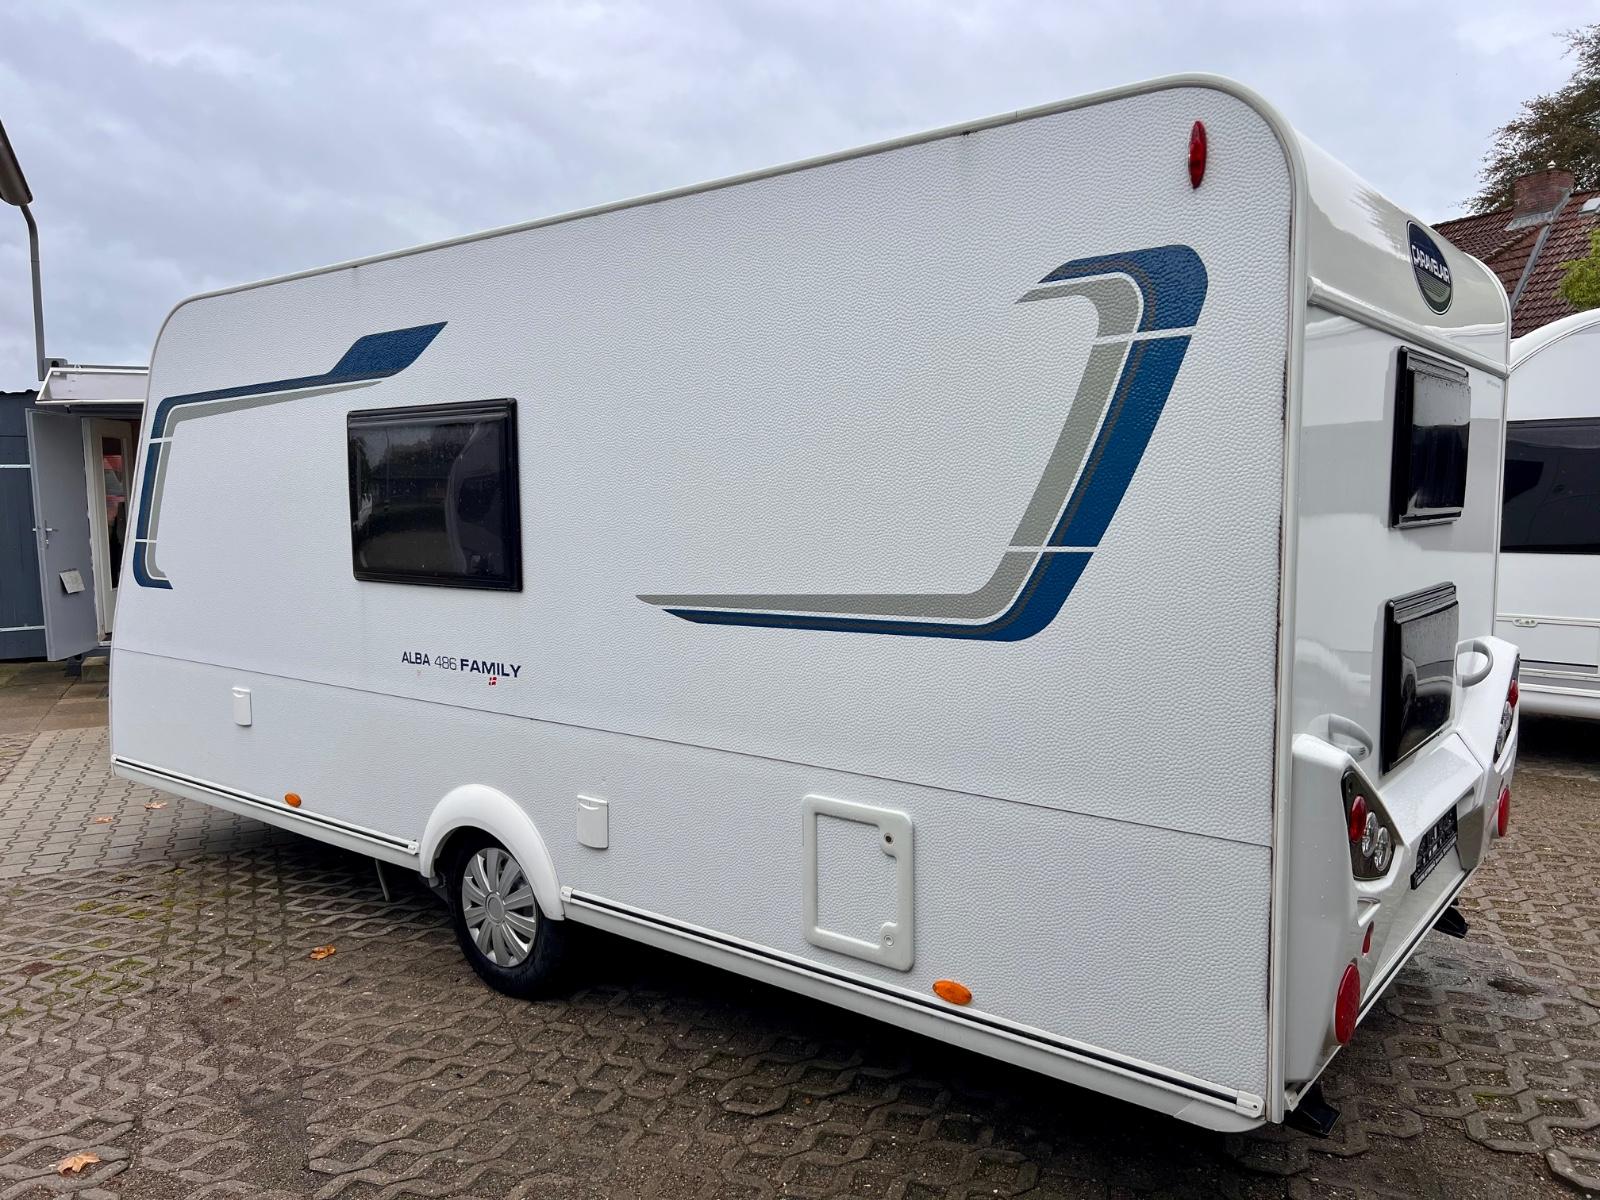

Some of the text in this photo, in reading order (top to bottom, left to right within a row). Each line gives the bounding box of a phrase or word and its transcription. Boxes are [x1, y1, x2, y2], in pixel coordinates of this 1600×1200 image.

[401, 651, 521, 678] ALBA 486 FAMILY
